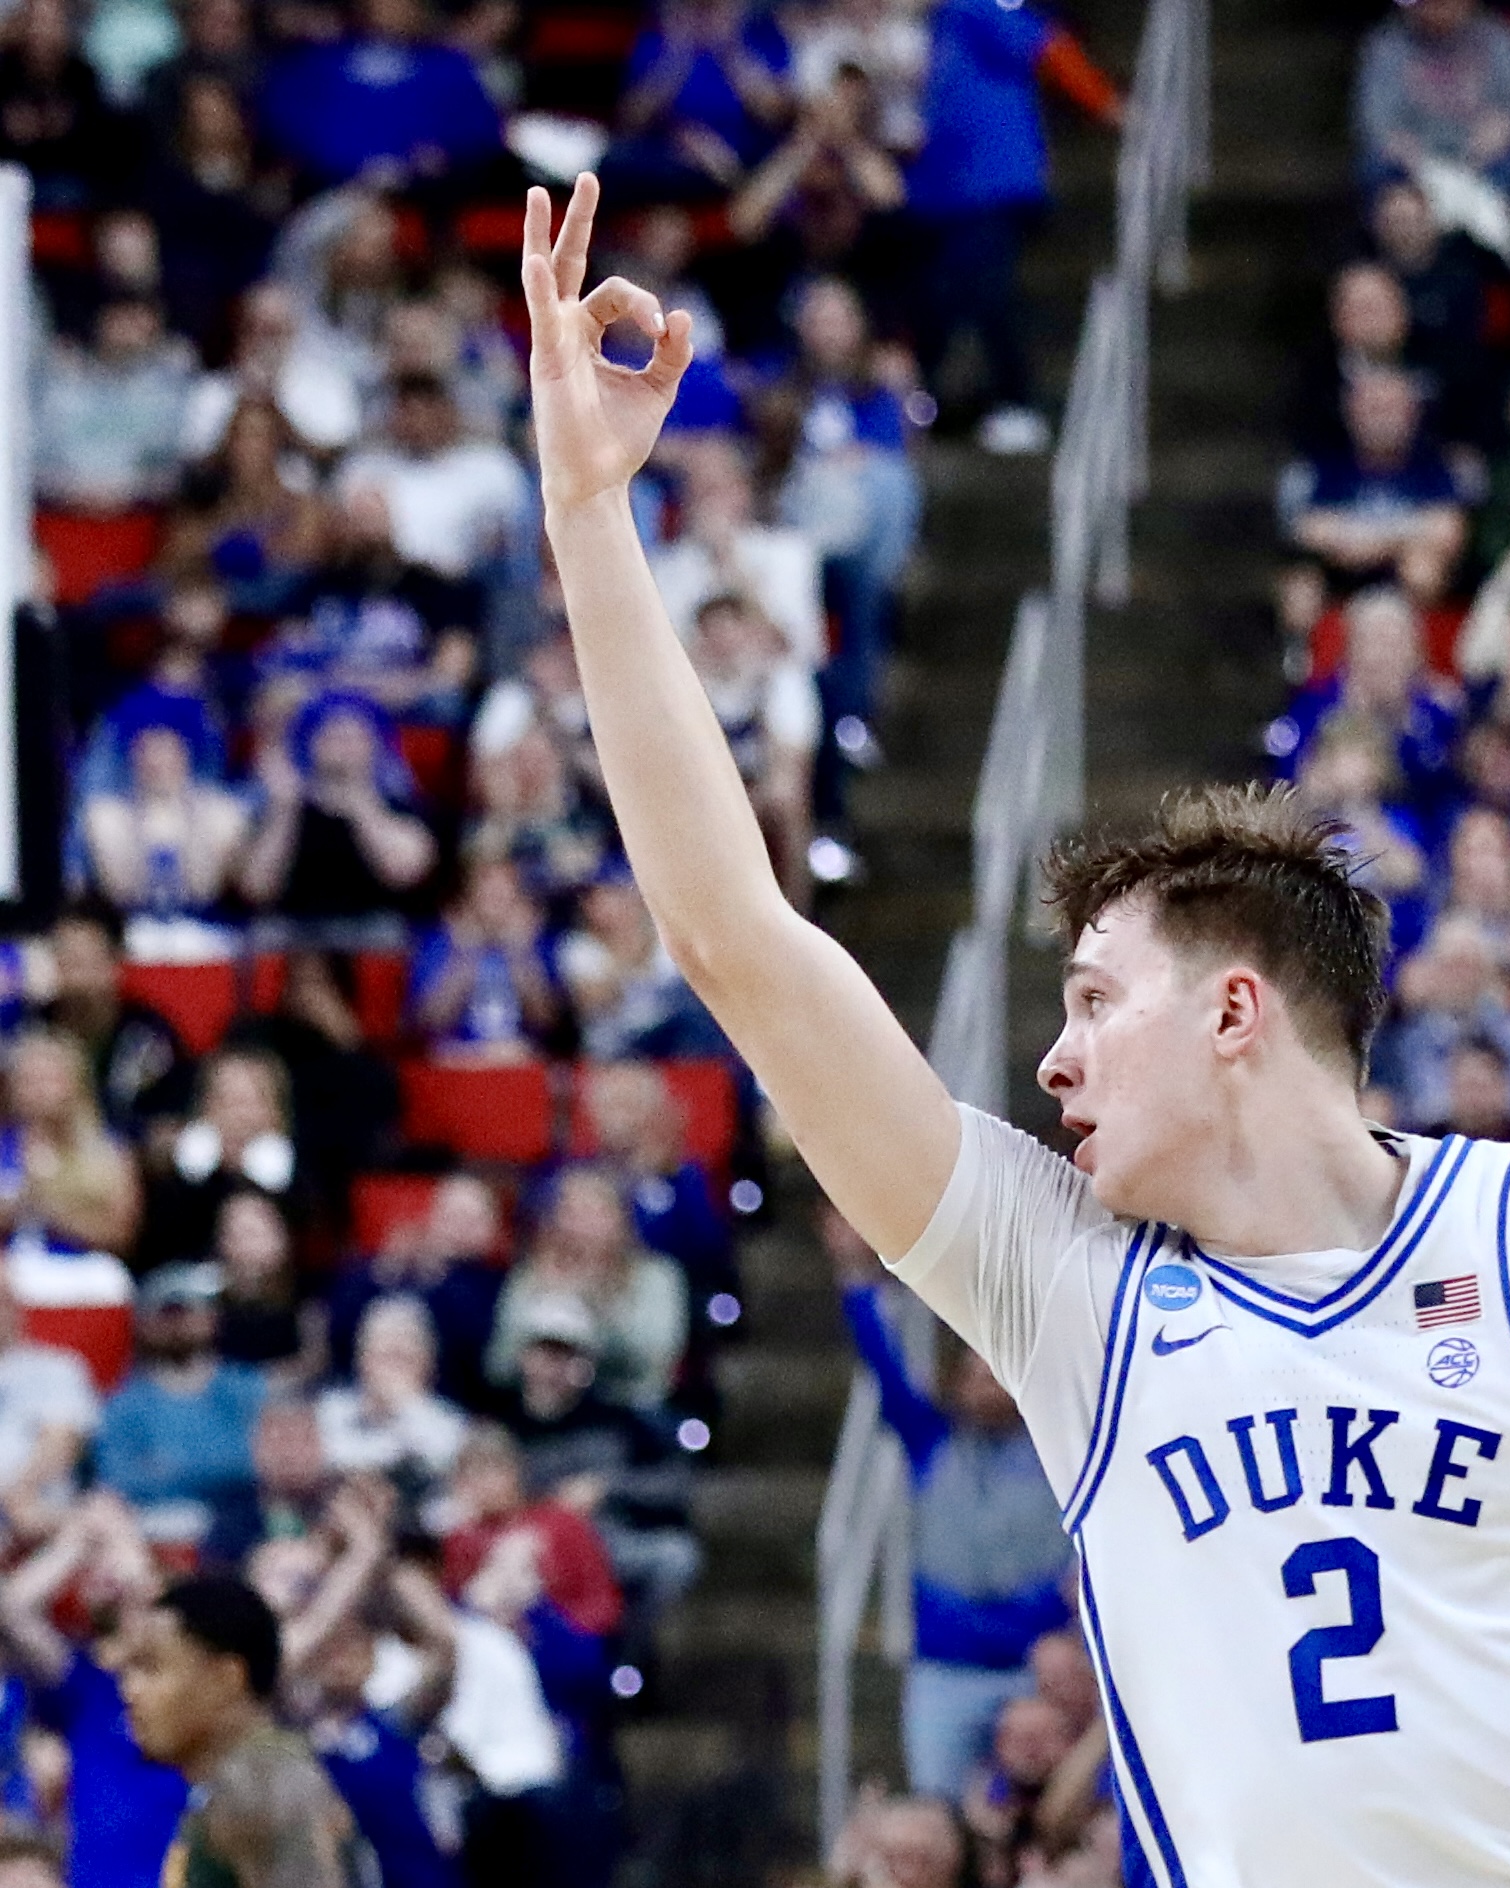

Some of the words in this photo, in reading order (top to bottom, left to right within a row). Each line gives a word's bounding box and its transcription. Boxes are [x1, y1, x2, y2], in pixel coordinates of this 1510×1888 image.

[1151, 1284, 1197, 1300] NCAA
[1433, 1351, 1475, 1368] ACC
[1145, 1405, 1503, 1543] DUKE
[1281, 1536, 1400, 1743] 2
